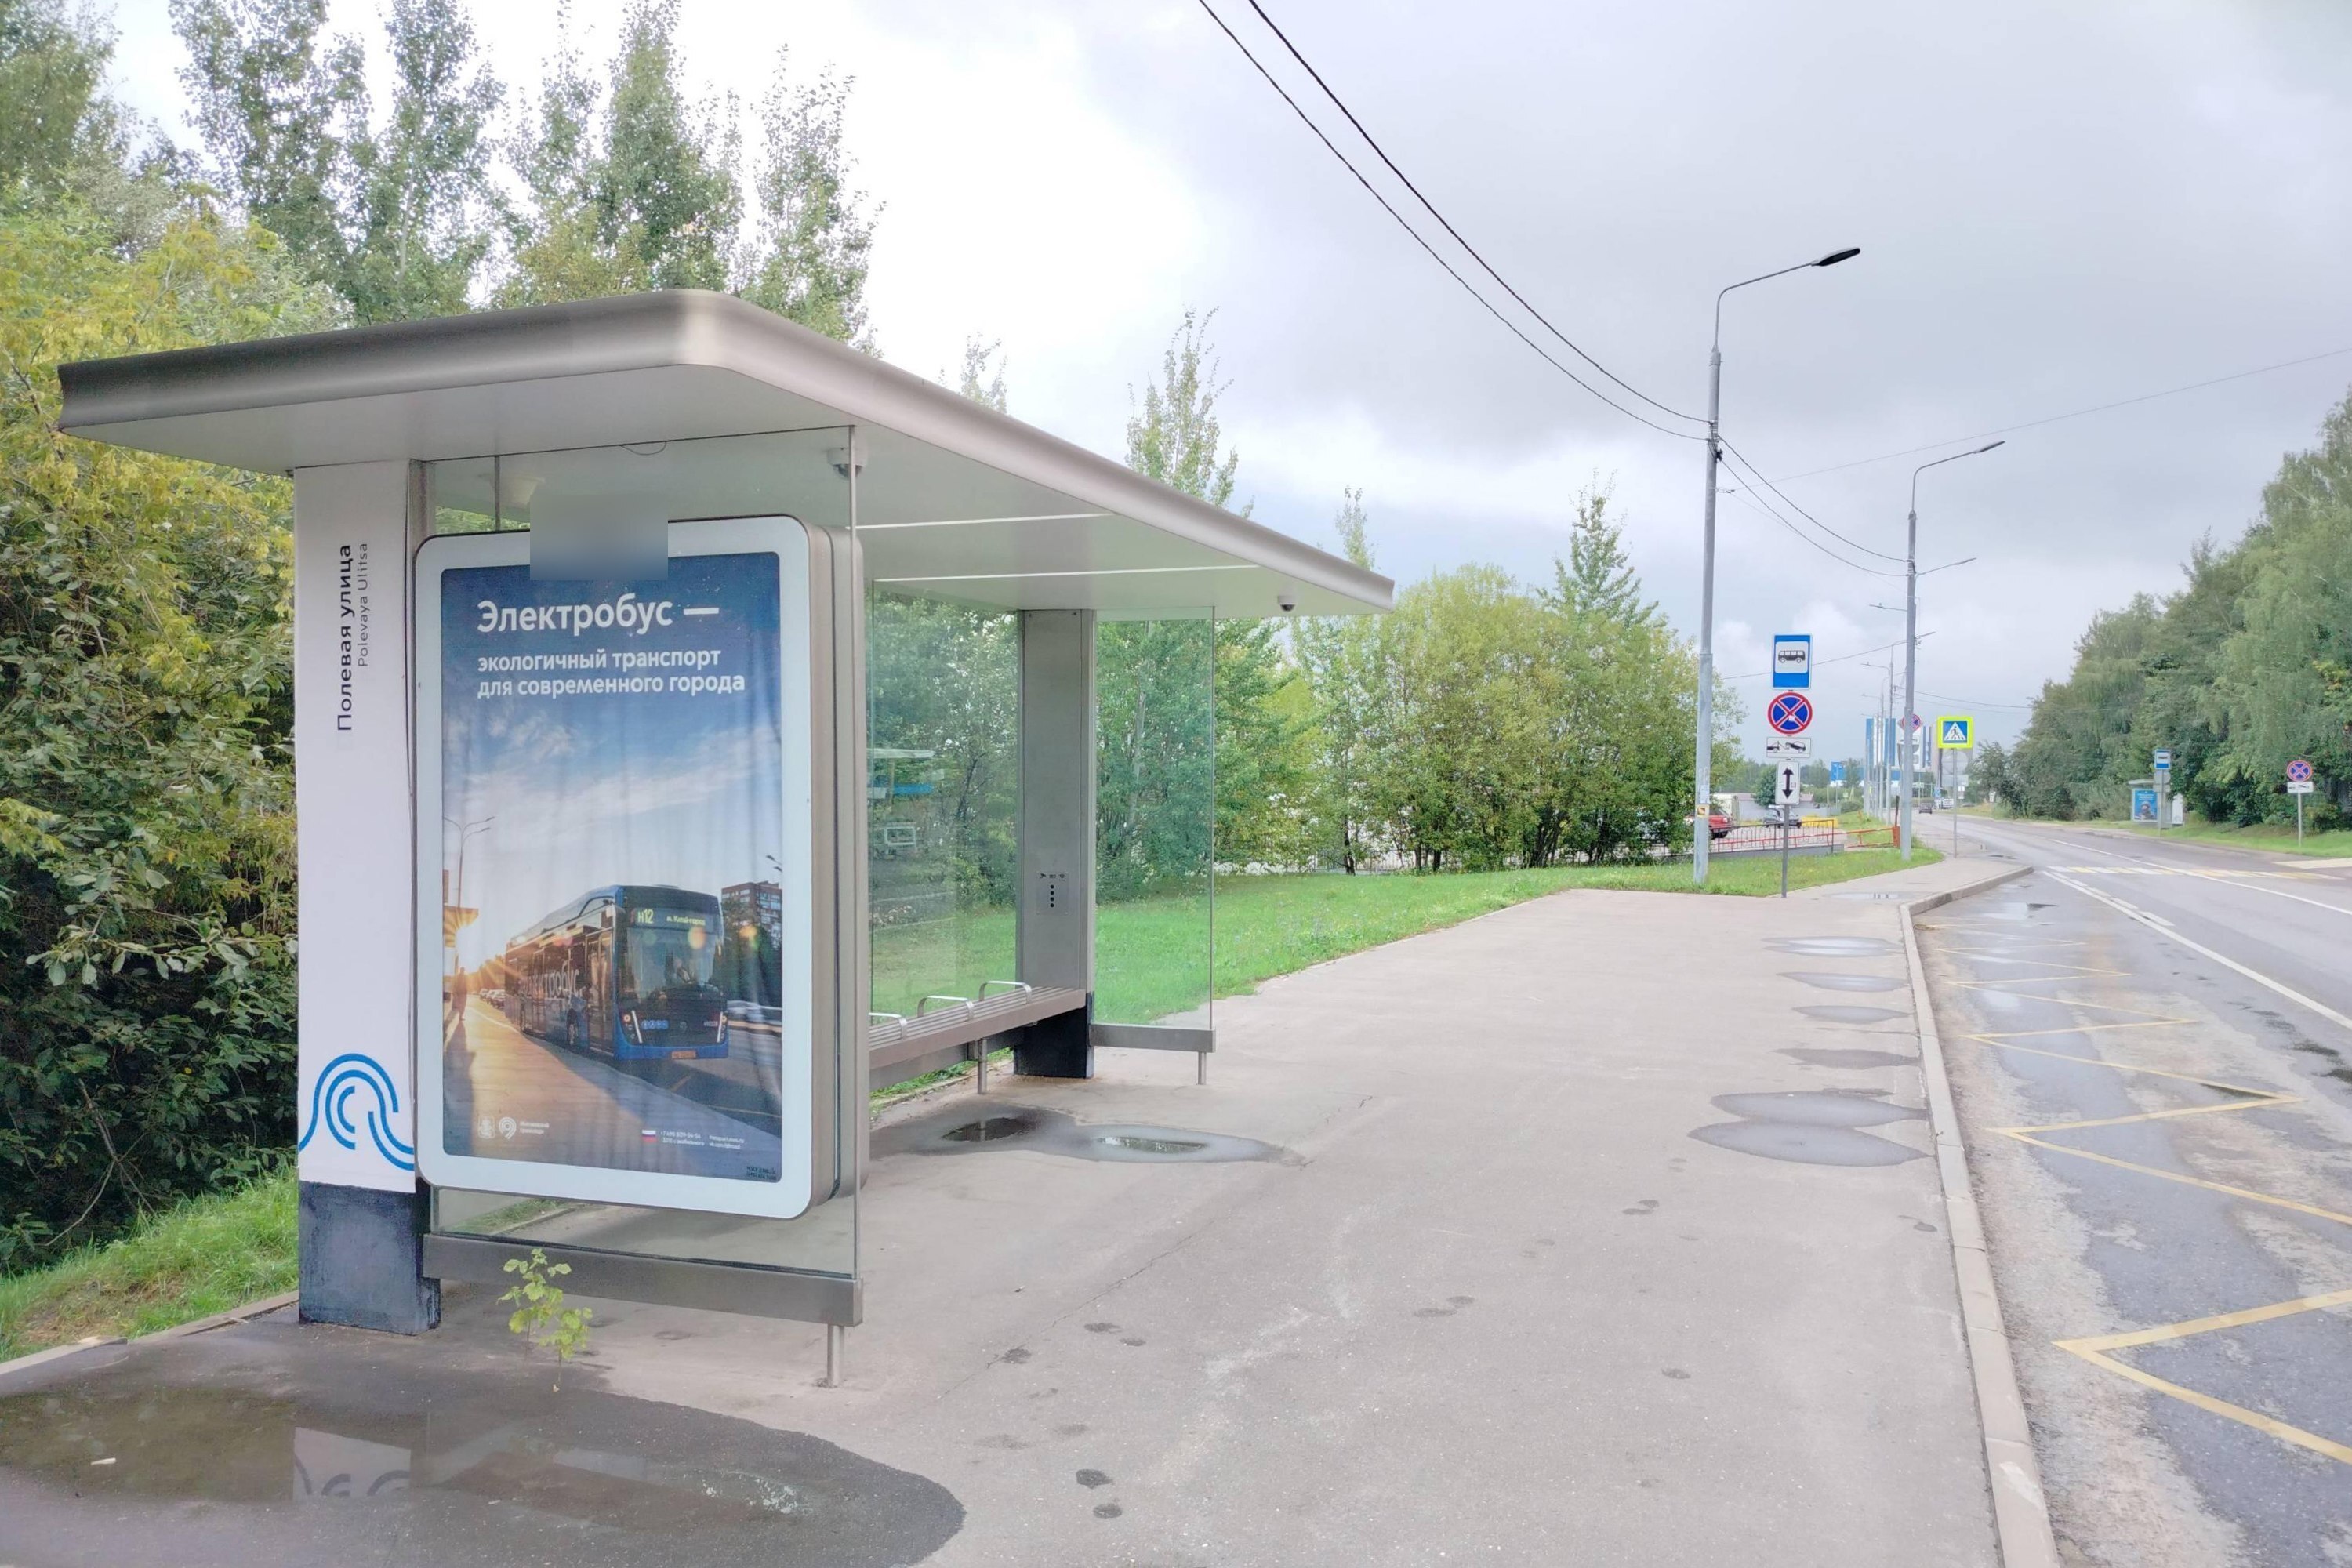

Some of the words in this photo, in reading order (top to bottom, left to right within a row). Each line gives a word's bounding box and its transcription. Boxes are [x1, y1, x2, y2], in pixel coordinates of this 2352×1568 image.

[340, 545, 355, 617] улица
[358, 543, 368, 590] Ulitsa
[358, 596, 370, 667] Polevaya
[477, 593, 673, 636] Электробус
[337, 626, 352, 731] Полевая
[477, 648, 607, 672] экологичный
[612, 650, 721, 672] транспорт
[477, 681, 512, 699] для
[517, 677, 664, 699] современного
[670, 675, 746, 696] города
